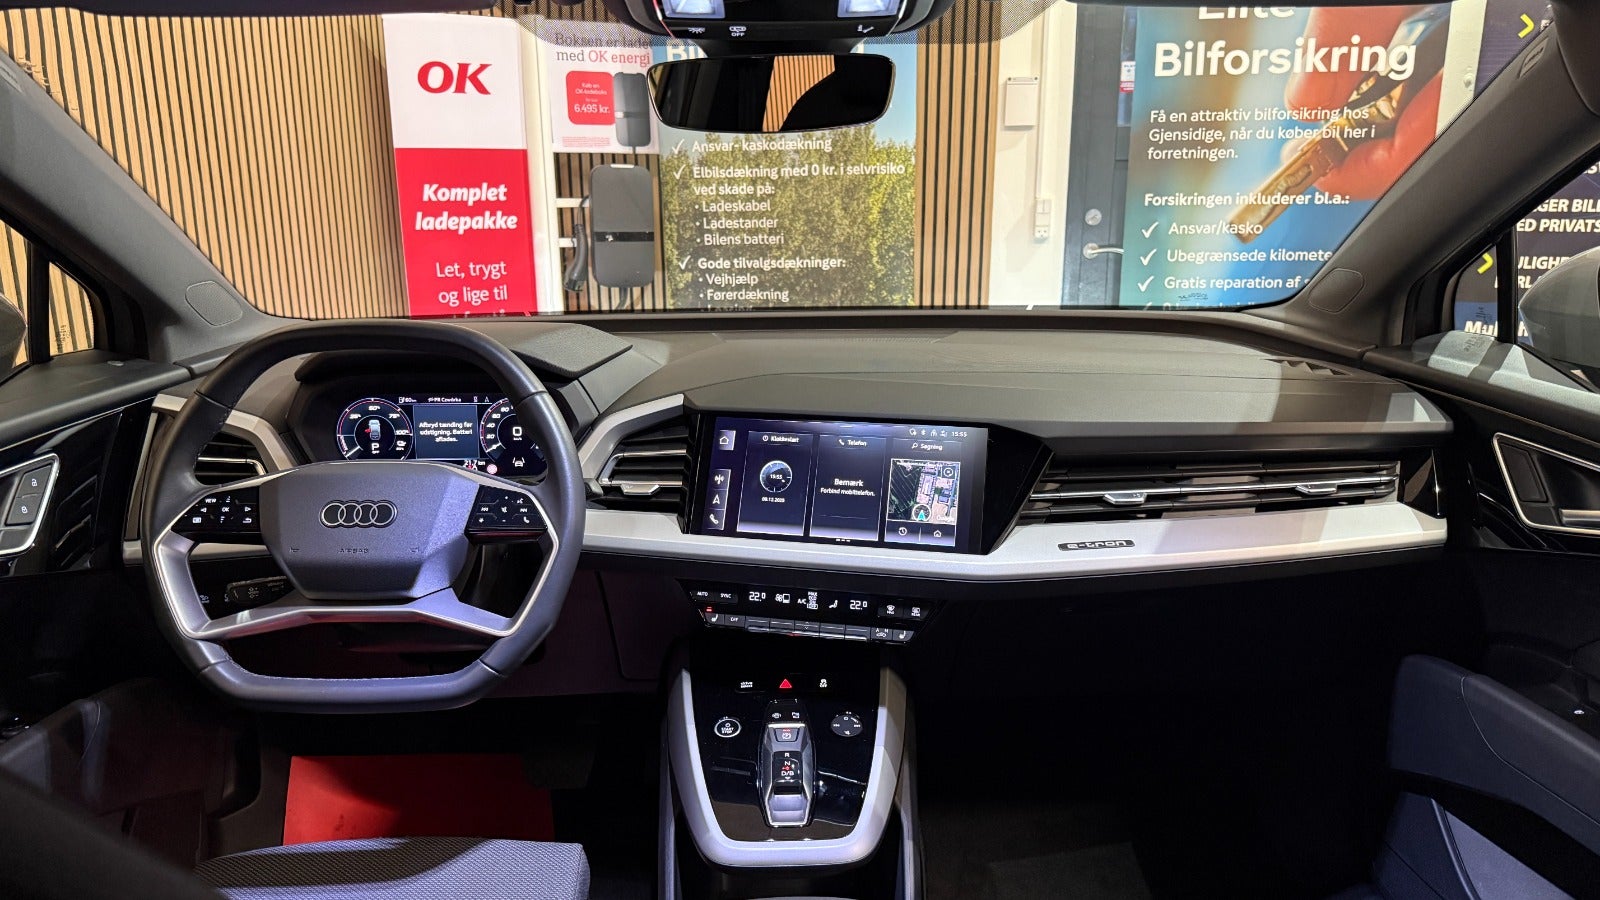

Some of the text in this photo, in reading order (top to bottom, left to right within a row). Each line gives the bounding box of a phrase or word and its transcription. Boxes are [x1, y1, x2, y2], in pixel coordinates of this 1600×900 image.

[556, 50, 650, 67] med OK energi
[1154, 35, 1416, 80] Bilforsikring
[417, 61, 492, 95] OK
[574, 104, 610, 114] 6.495 kr.
[1150, 107, 1369, 123] Få en attraktiv bilforsikring hos
[1149, 126, 1375, 143] Gjensidige, når du køber bil her i
[692, 138, 832, 152] Ansvar- kaskodækning
[1148, 147, 1239, 163] forretningen.
[693, 163, 905, 180] Elbilsdækning med 0 kr. i selvrisiko
[422, 182, 507, 206] Komplet
[694, 182, 775, 197] ved skade på:
[702, 201, 771, 212] Ladeskabel
[1144, 192, 1350, 209] Forsikringen inkluderer bl.a.:
[415, 211, 518, 234] ladepakke
[703, 218, 778, 229] Ladestander
[1168, 221, 1263, 235] Ansvar/kasko
[1516, 218, 1537, 232] ED
[704, 233, 784, 246] Bilens batteri
[698, 257, 846, 270] Gode tilvalgsdækninger:
[1167, 248, 1334, 265] Ubegrænsede kilomete
[436, 261, 507, 280] Let, trygt
[706, 274, 759, 287] Vejhjælp
[1164, 276, 1207, 289] Gratis
[1210, 276, 1282, 291] reparation
[1286, 276, 1302, 288] af
[438, 284, 508, 307] og lige til
[707, 288, 789, 302] Førerdækning
[513, 426, 522, 436] 0
[834, 478, 864, 486] Bemærk
[1067, 540, 1126, 549] e-tron
